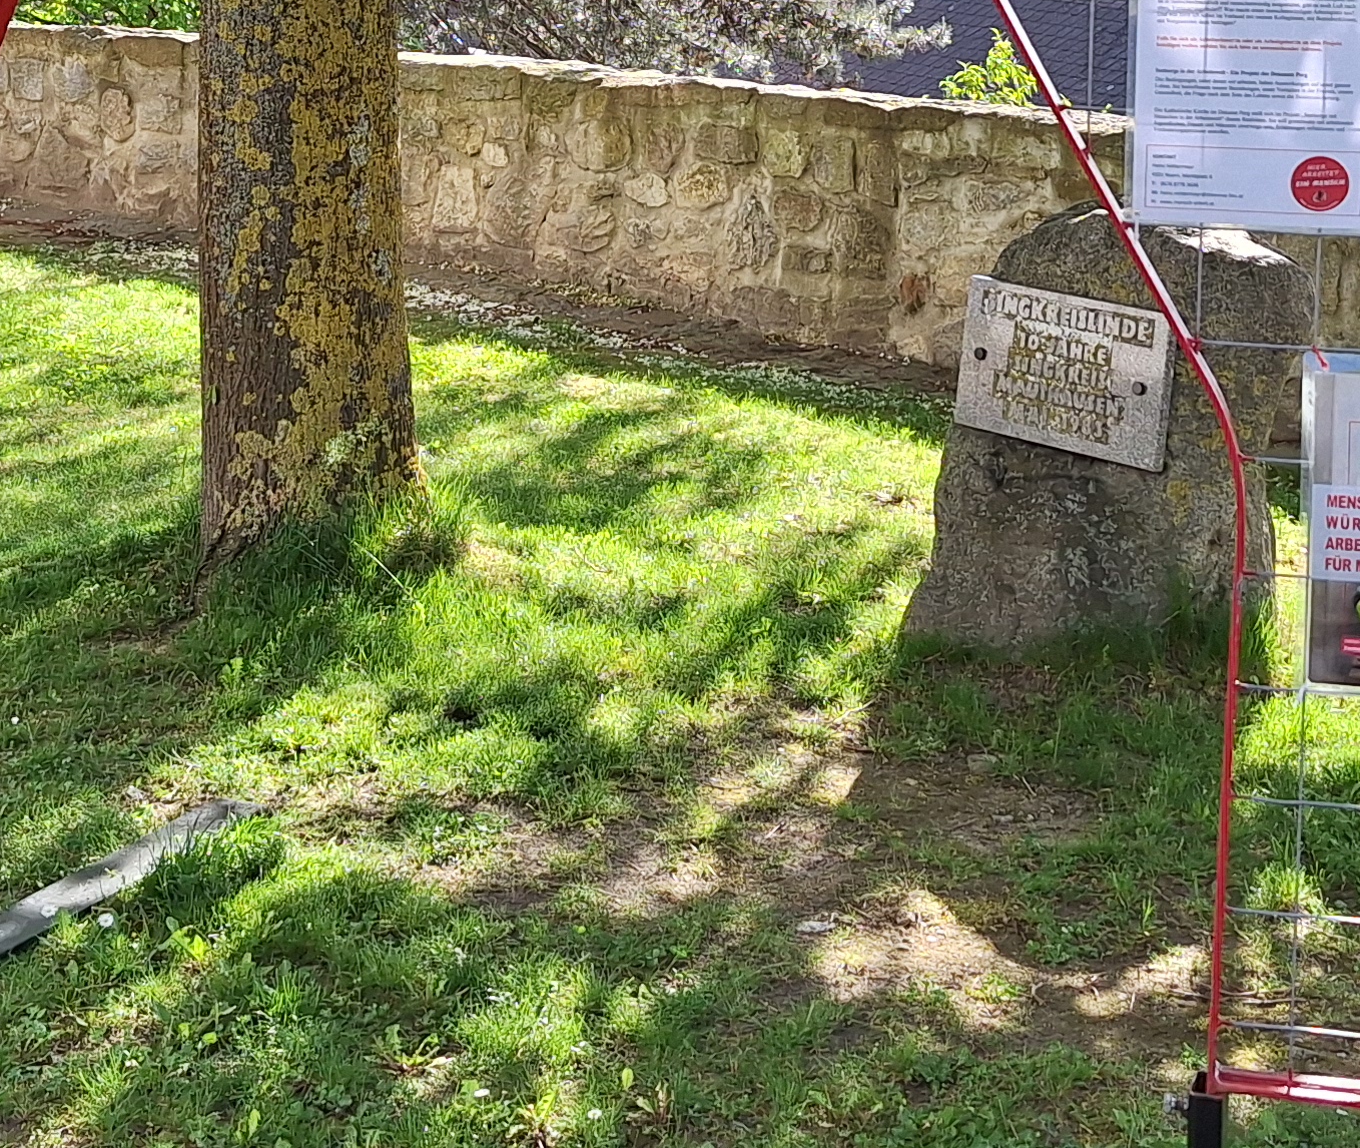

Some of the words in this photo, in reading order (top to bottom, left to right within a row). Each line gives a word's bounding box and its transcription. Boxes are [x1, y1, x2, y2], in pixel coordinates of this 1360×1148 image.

[1017, 331, 1039, 350] 10
[1042, 337, 1109, 365] JAHRE
[1325, 556, 1351, 572] FÜR
